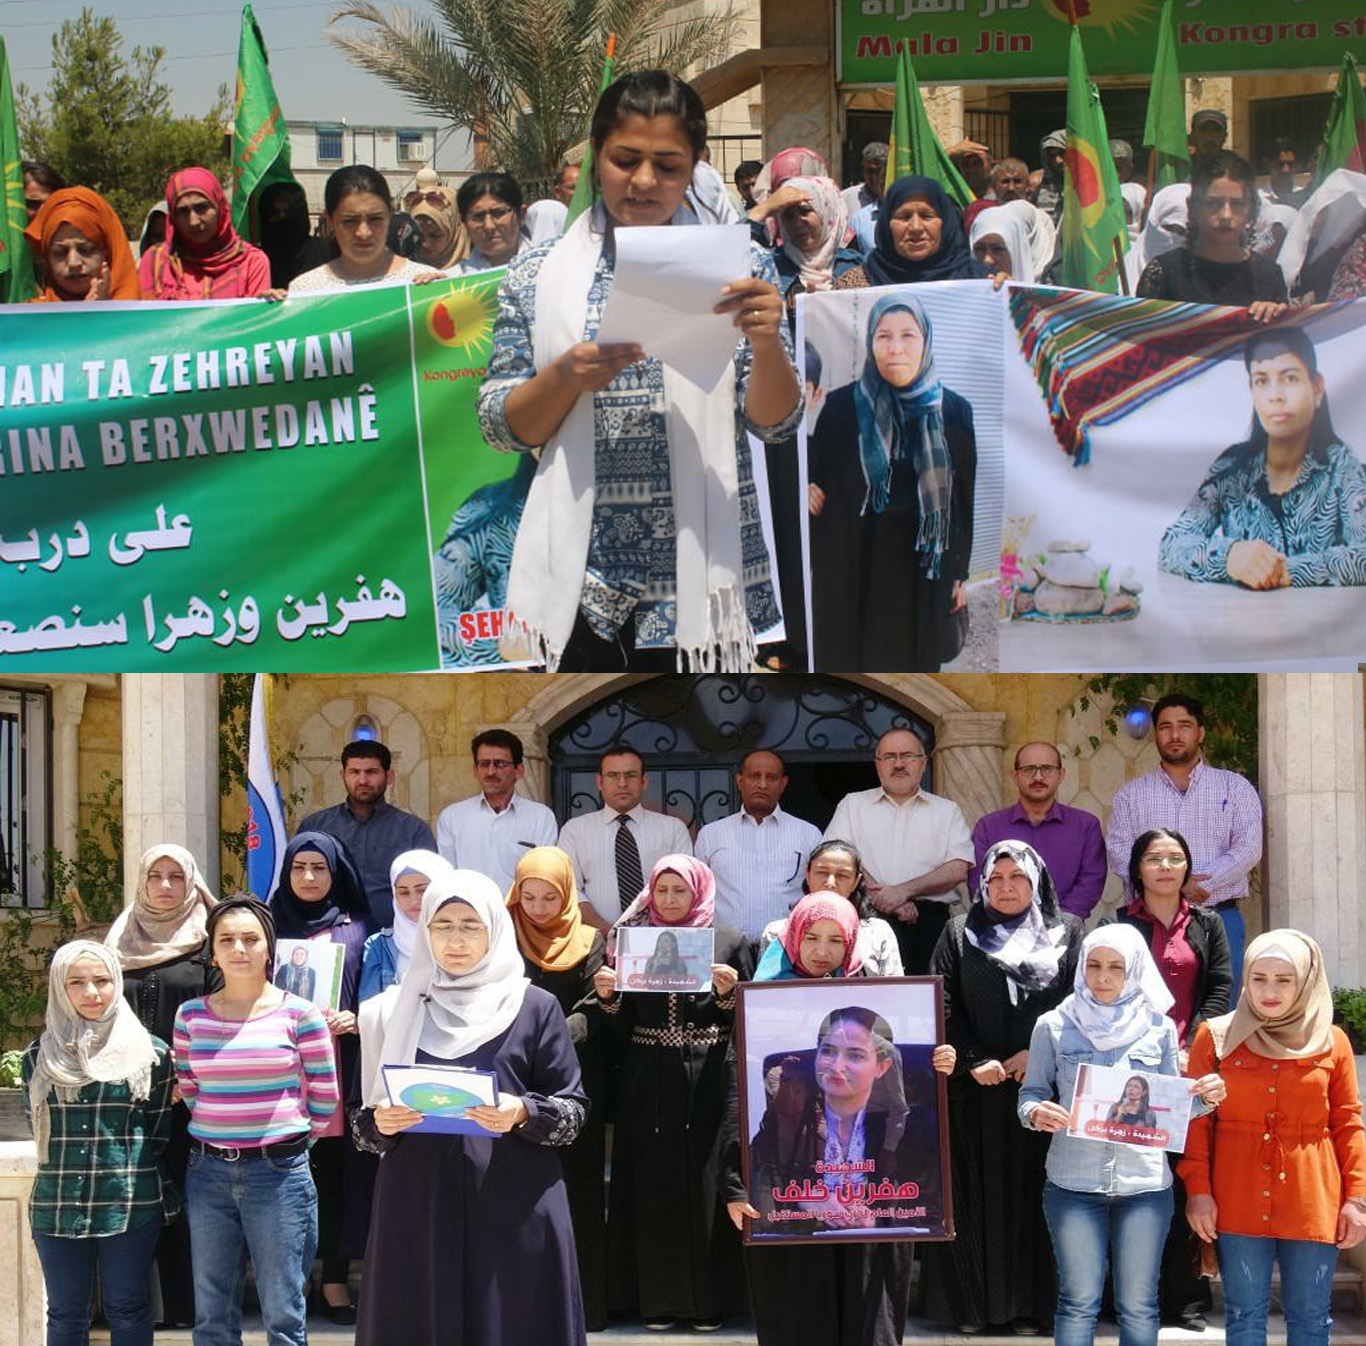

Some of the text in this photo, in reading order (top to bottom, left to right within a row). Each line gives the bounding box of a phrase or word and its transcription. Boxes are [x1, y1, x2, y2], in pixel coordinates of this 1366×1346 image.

[974, 31, 1034, 54] Jin
[1178, 20, 1319, 46] Kongra
[82, 358, 134, 401] TA
[149, 330, 356, 396] ZEHREYAN
[99, 382, 381, 467] BERXWEDANÊ
[0, 502, 194, 573] على درب
[142, 588, 261, 653] وزهرا
[276, 573, 407, 641] هفرين
[772, 1177, 920, 1207] هفرين خلف
